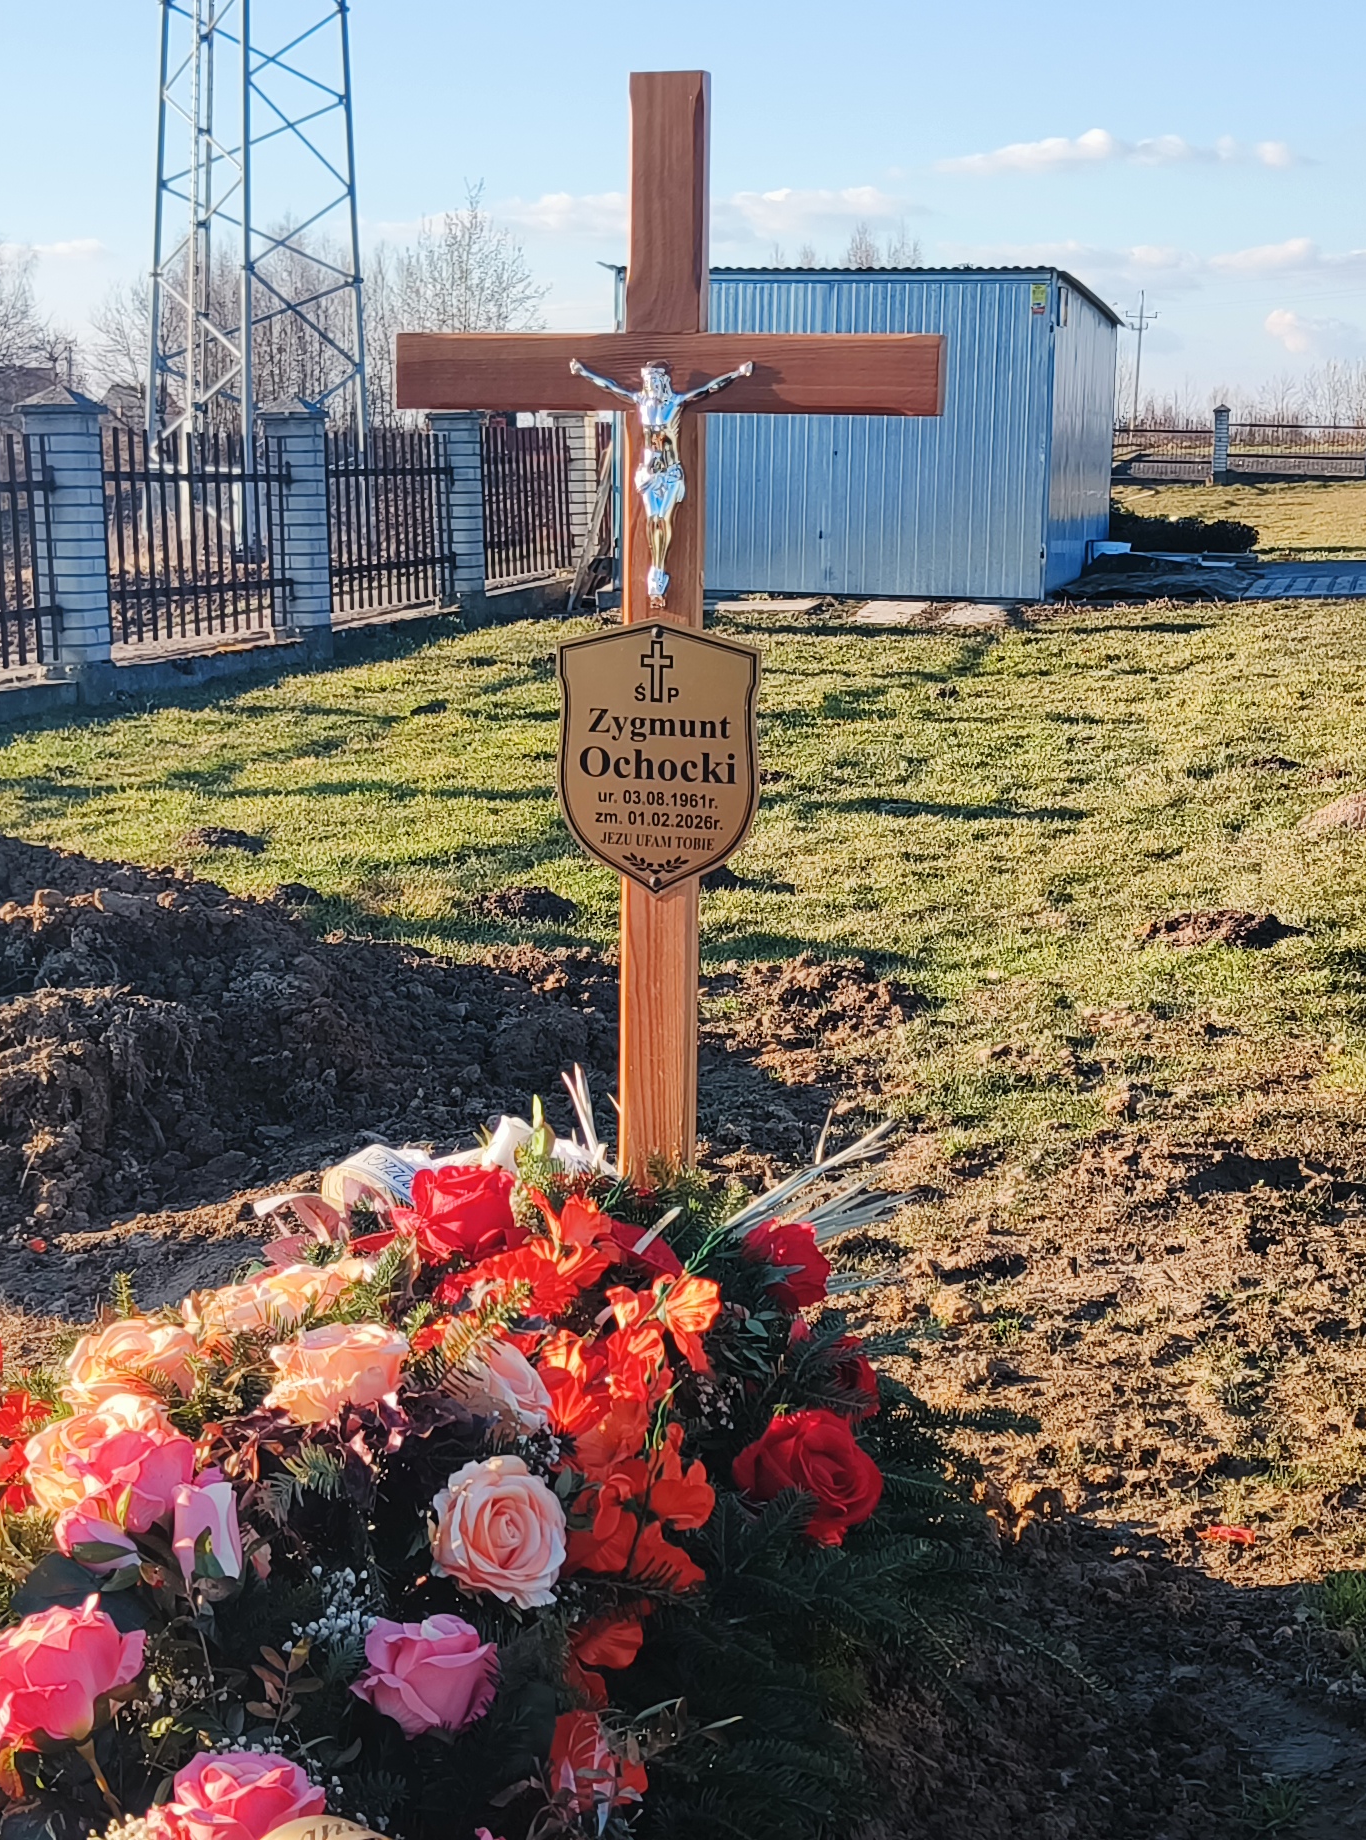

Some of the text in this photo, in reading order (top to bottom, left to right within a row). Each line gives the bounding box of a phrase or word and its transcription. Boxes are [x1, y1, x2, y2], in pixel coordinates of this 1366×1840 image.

[633, 682, 680, 703] Ś P
[588, 707, 732, 743] Zygmunt
[579, 745, 738, 785] Ochocki
[597, 789, 719, 810] ur. 03.08.1961r.
[595, 810, 724, 831] zm. 01.02.2026r.
[599, 831, 716, 852] JEZU UFAM TOBIE
